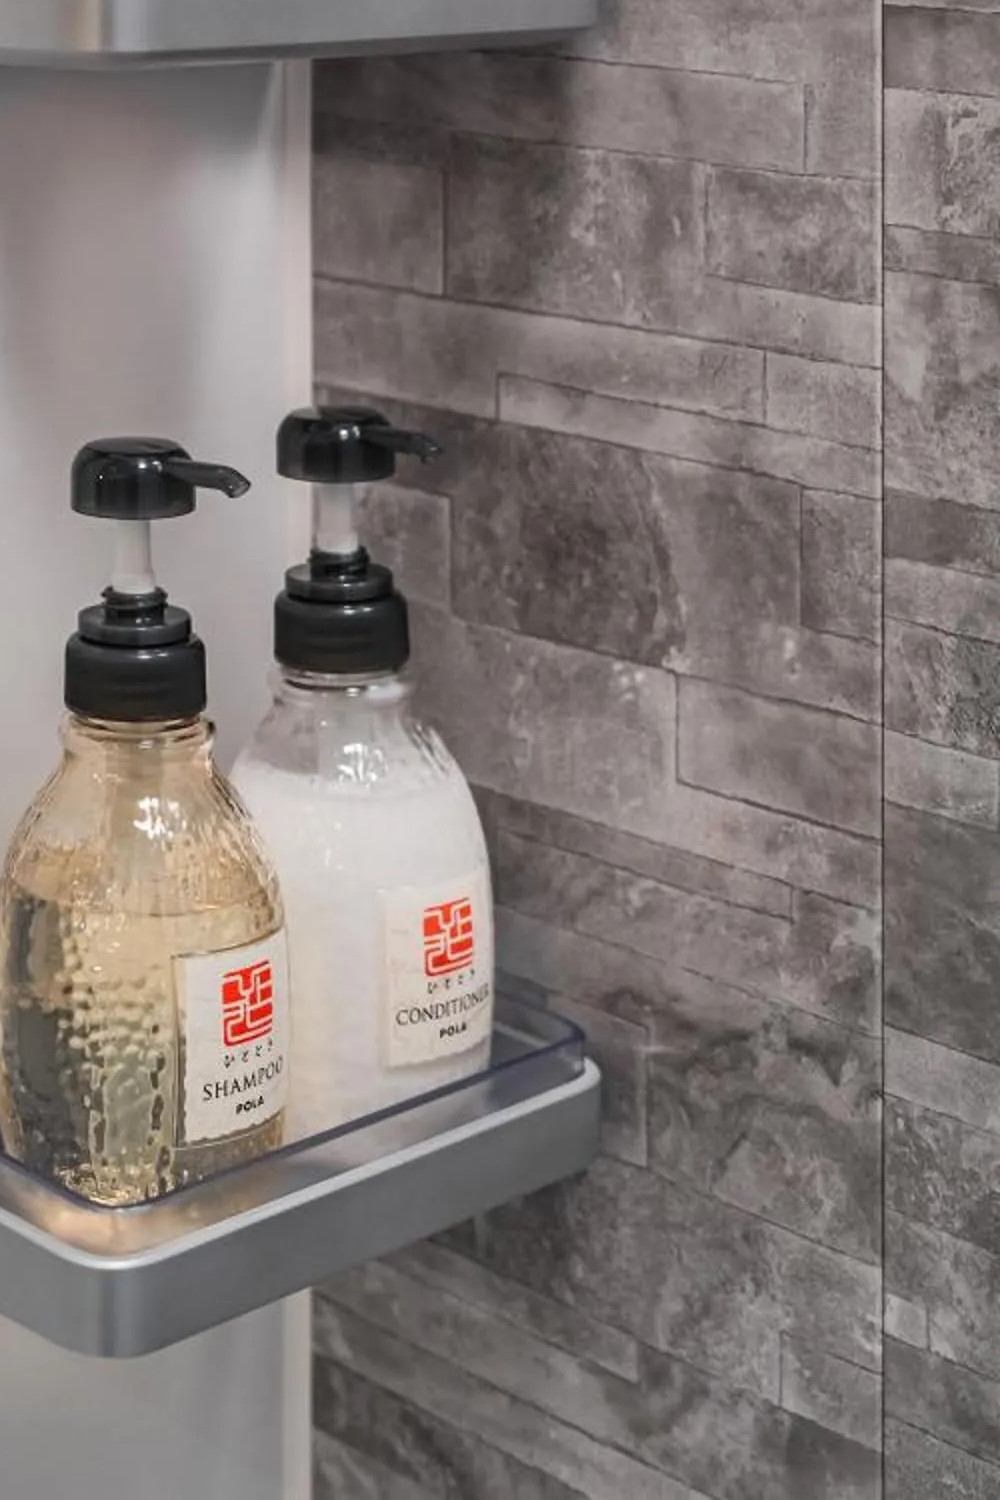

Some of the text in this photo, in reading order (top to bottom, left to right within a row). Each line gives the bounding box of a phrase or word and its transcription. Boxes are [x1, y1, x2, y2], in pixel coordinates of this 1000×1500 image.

[439, 1021, 468, 1039] POLA
[202, 1055, 283, 1102] SHAMPOO
[235, 1095, 265, 1115] POLA
